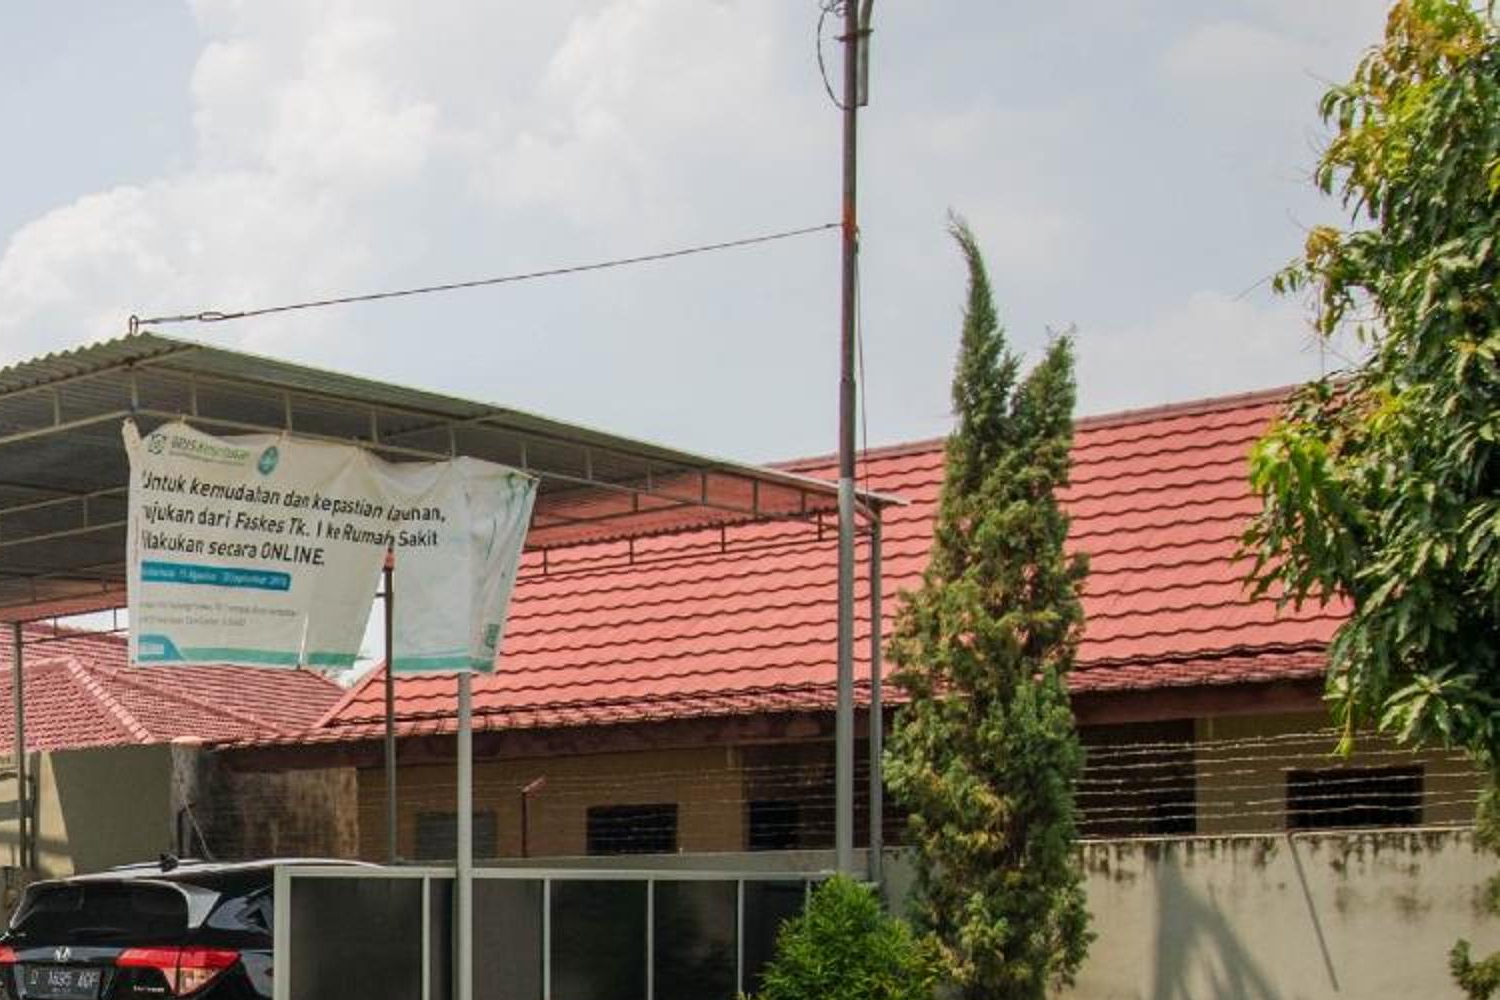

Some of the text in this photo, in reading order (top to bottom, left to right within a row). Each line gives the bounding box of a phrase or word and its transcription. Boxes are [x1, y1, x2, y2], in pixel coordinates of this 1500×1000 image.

[311, 493, 383, 517] kepastian
[142, 499, 194, 525] ujukan
[198, 506, 231, 528] dari
[288, 517, 310, 537] Tk.
[341, 522, 395, 548] Rumah
[397, 530, 438, 548] Sakit
[207, 540, 257, 560] secara
